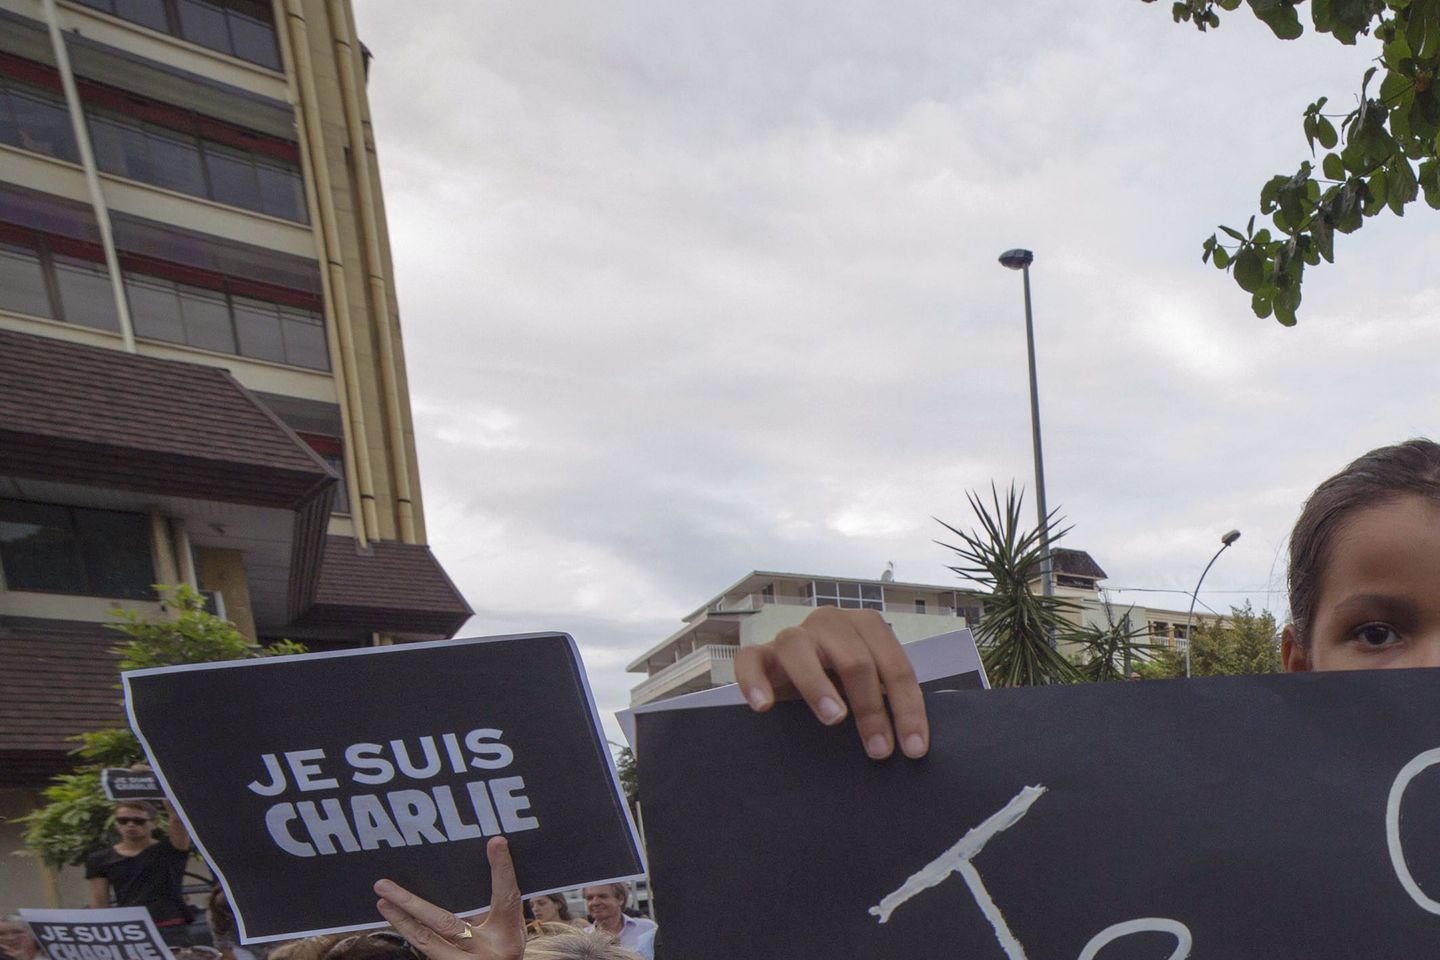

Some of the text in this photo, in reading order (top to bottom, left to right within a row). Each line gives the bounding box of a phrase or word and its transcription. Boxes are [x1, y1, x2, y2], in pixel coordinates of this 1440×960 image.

[247, 728, 514, 796] JE SUIS
[264, 775, 540, 858] CHARLIE
[40, 924, 147, 943] JE SUIS
